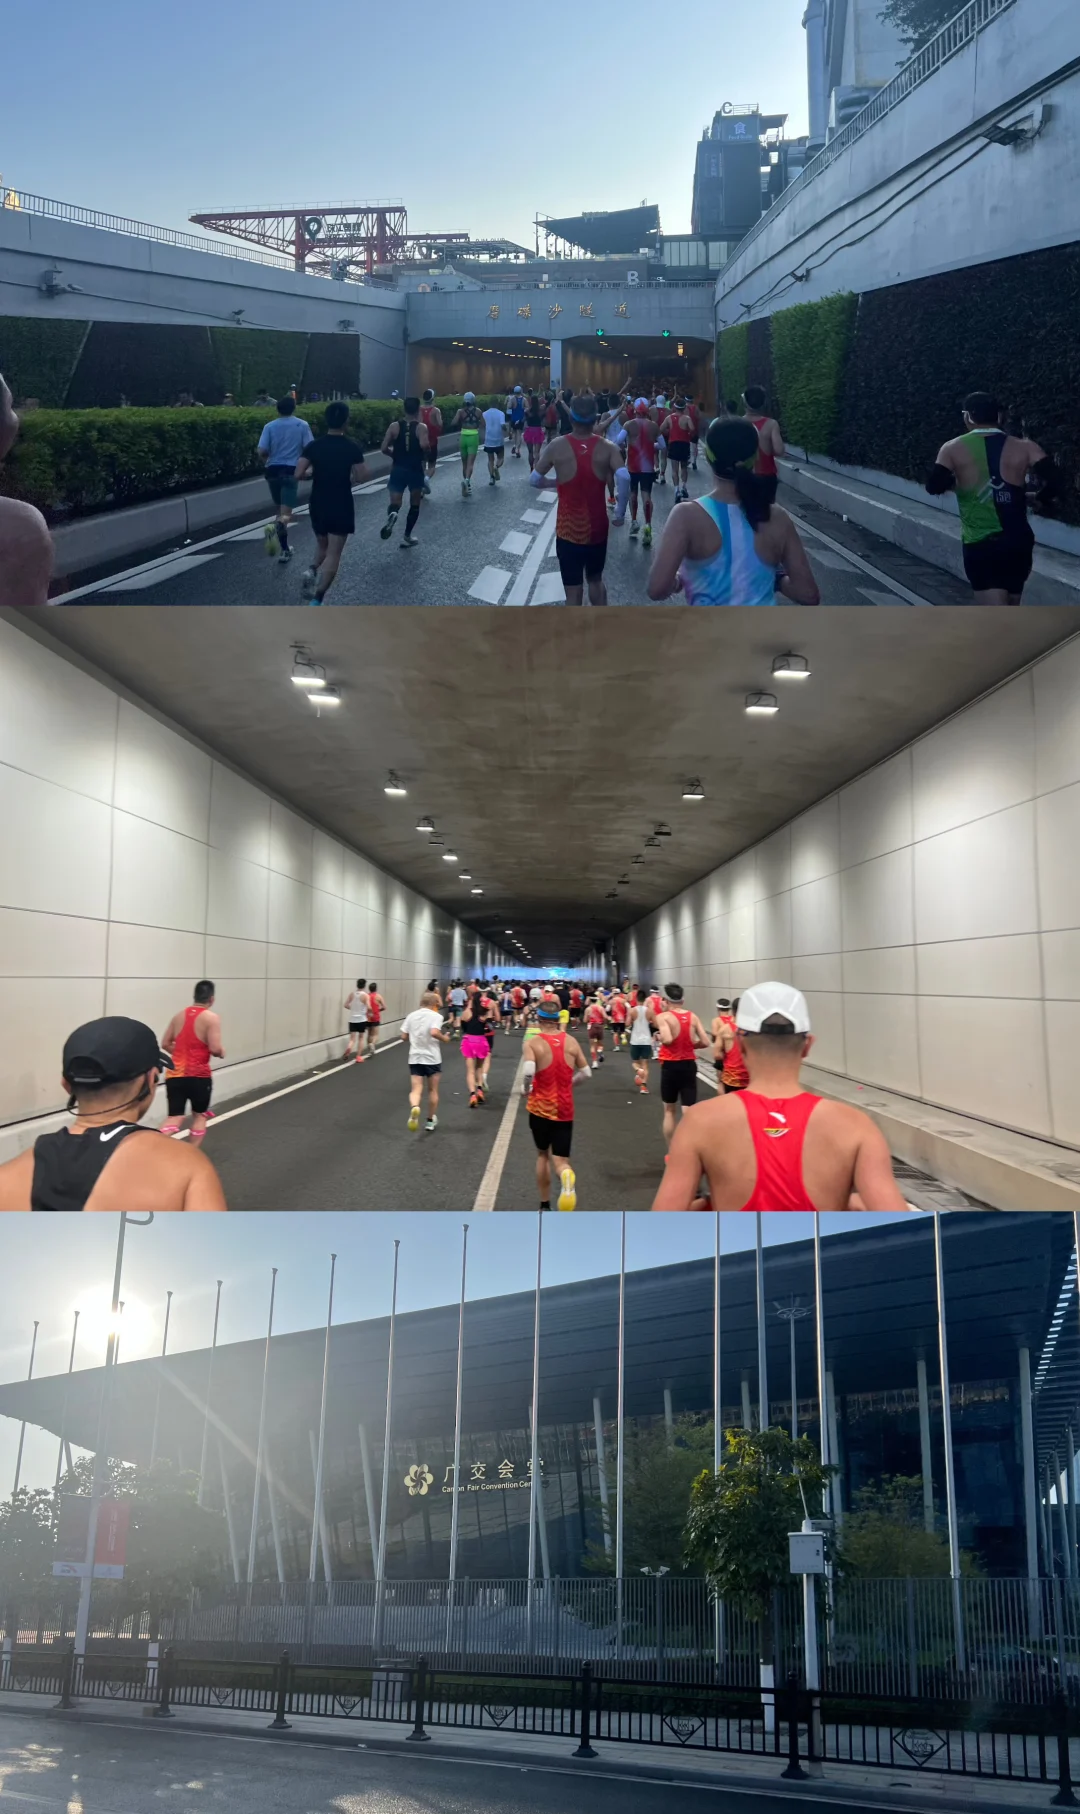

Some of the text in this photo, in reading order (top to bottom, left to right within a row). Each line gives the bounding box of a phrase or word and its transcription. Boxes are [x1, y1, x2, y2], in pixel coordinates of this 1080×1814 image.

[722, 102, 733, 114] C
[627, 270, 640, 285] B
[441, 1485, 465, 1493] Canon
[481, 1482, 518, 1490] Convention
